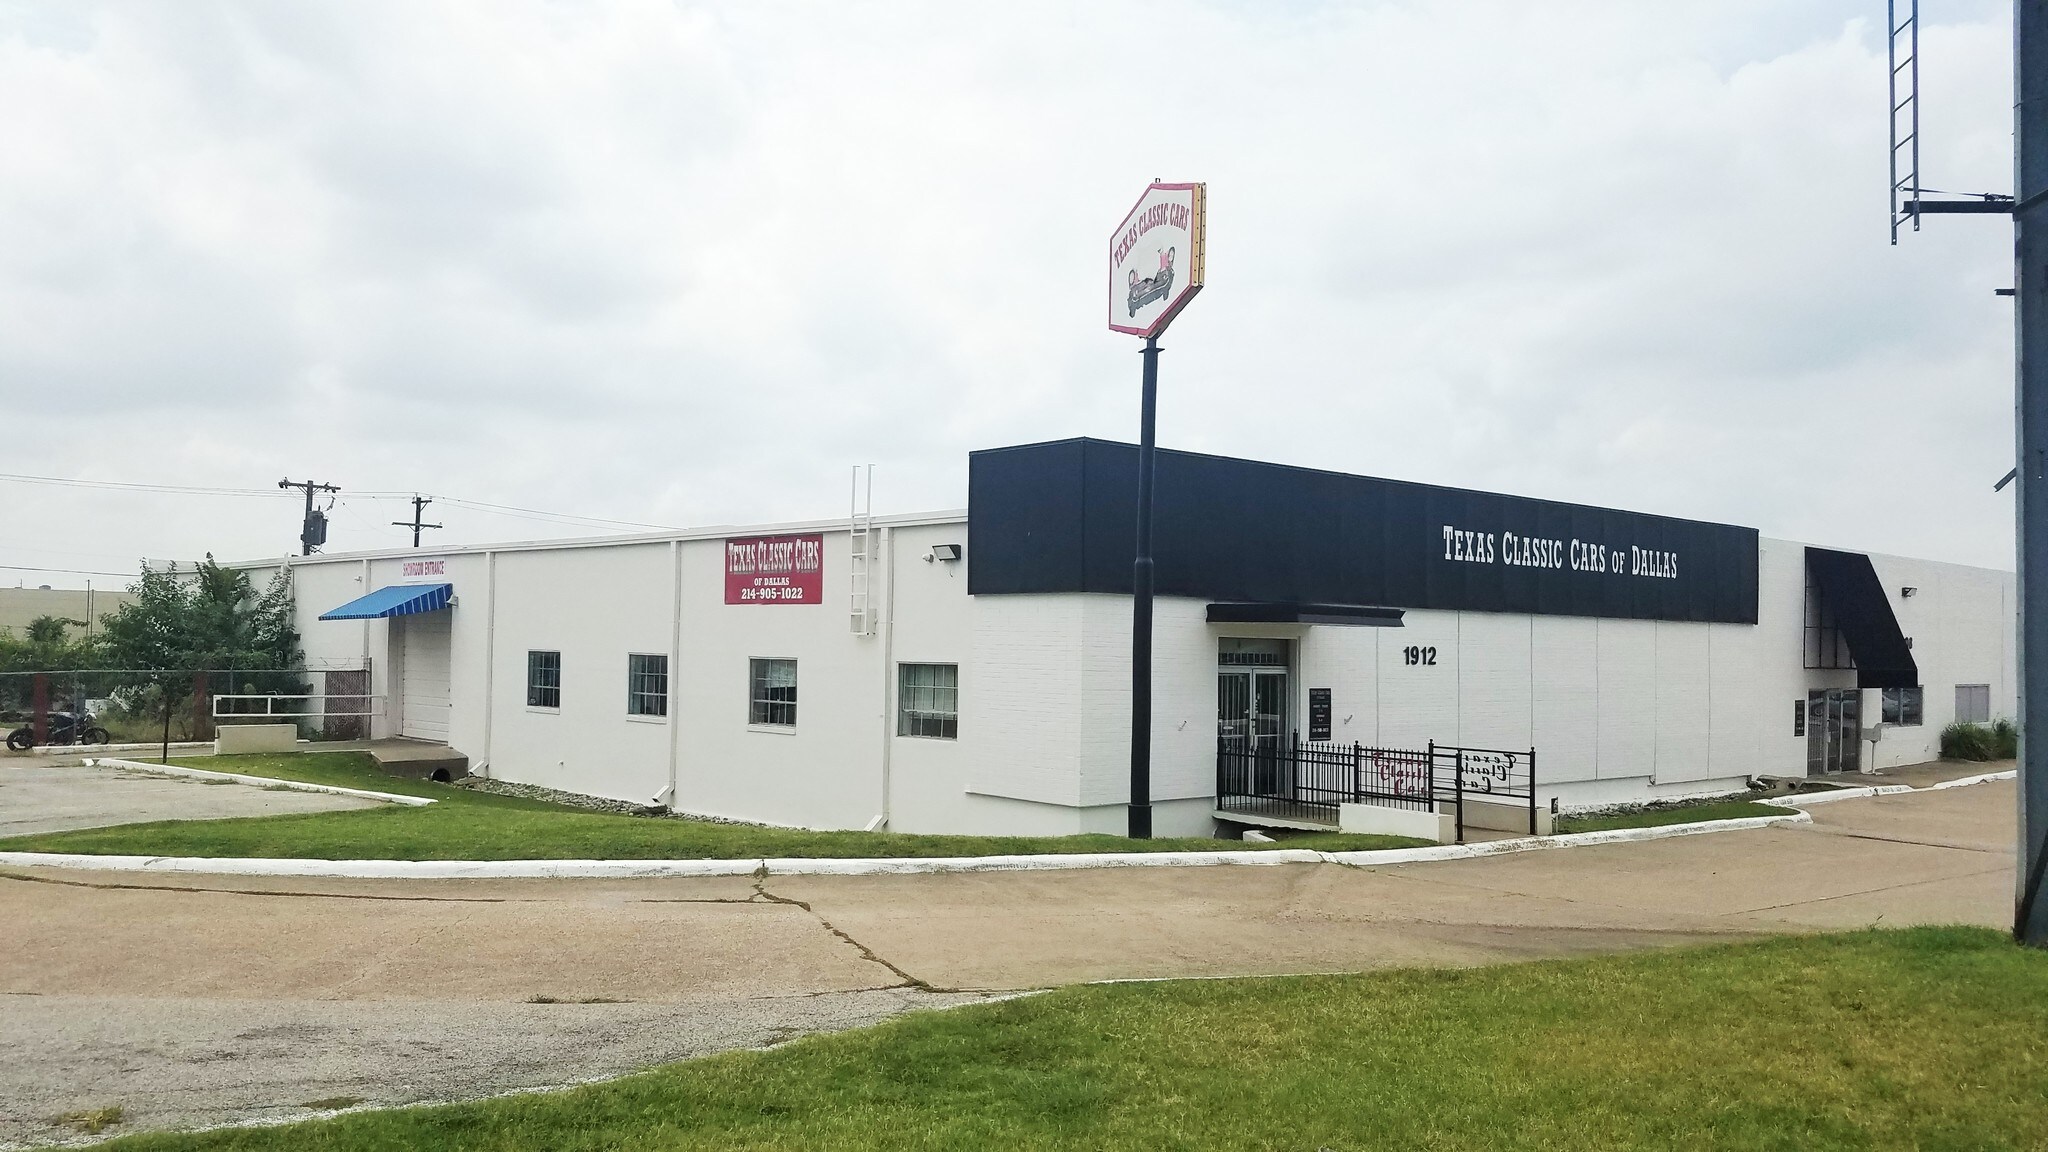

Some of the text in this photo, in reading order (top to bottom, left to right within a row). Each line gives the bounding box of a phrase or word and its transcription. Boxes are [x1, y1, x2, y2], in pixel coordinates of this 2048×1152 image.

[1114, 202, 1189, 269] TEXAS CLASSIC CARS
[728, 538, 819, 572] TEXAS CLASSIC CARS
[1443, 525, 1677, 579] TEXAS CLASSIC CARS OF DALLAS
[425, 561, 444, 575] ENTRANCE
[754, 577, 790, 586] OF DALLAS
[741, 588, 803, 600] 214-905-1022
[1403, 645, 1437, 666] 1912
